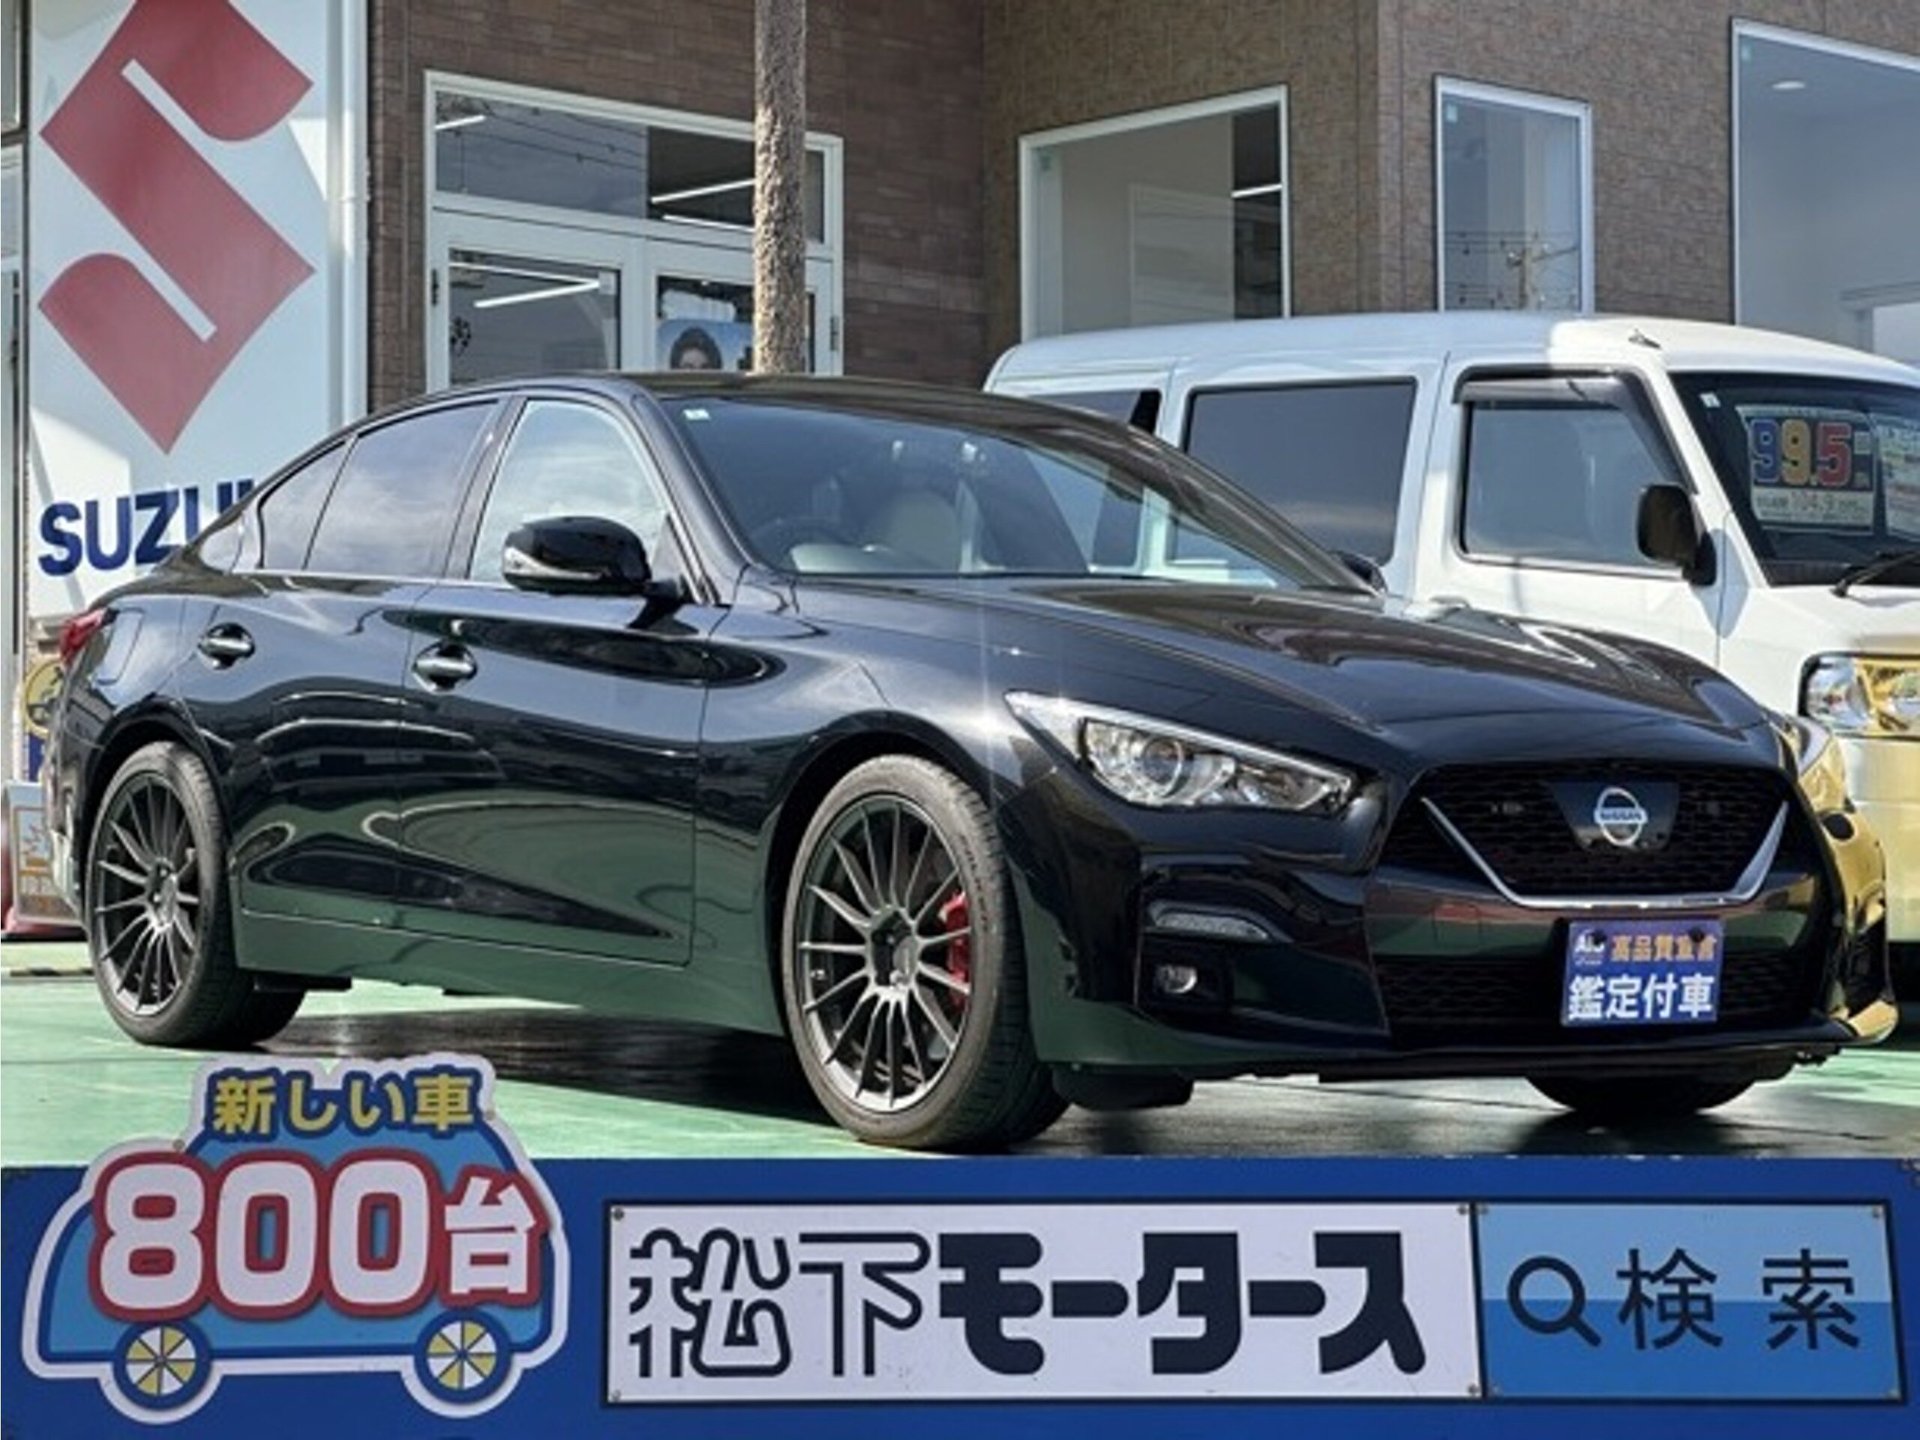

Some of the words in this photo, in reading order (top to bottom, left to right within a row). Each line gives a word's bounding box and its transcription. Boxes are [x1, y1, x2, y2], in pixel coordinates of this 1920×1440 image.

[1749, 417, 1852, 488] 99.5
[37, 479, 254, 577] SUZU
[1568, 973, 1716, 1020] 鑑定付車
[212, 1074, 475, 1135] 新しい車
[99, 1160, 538, 1308] 800台
[629, 1228, 1427, 1378] 松下モータース
